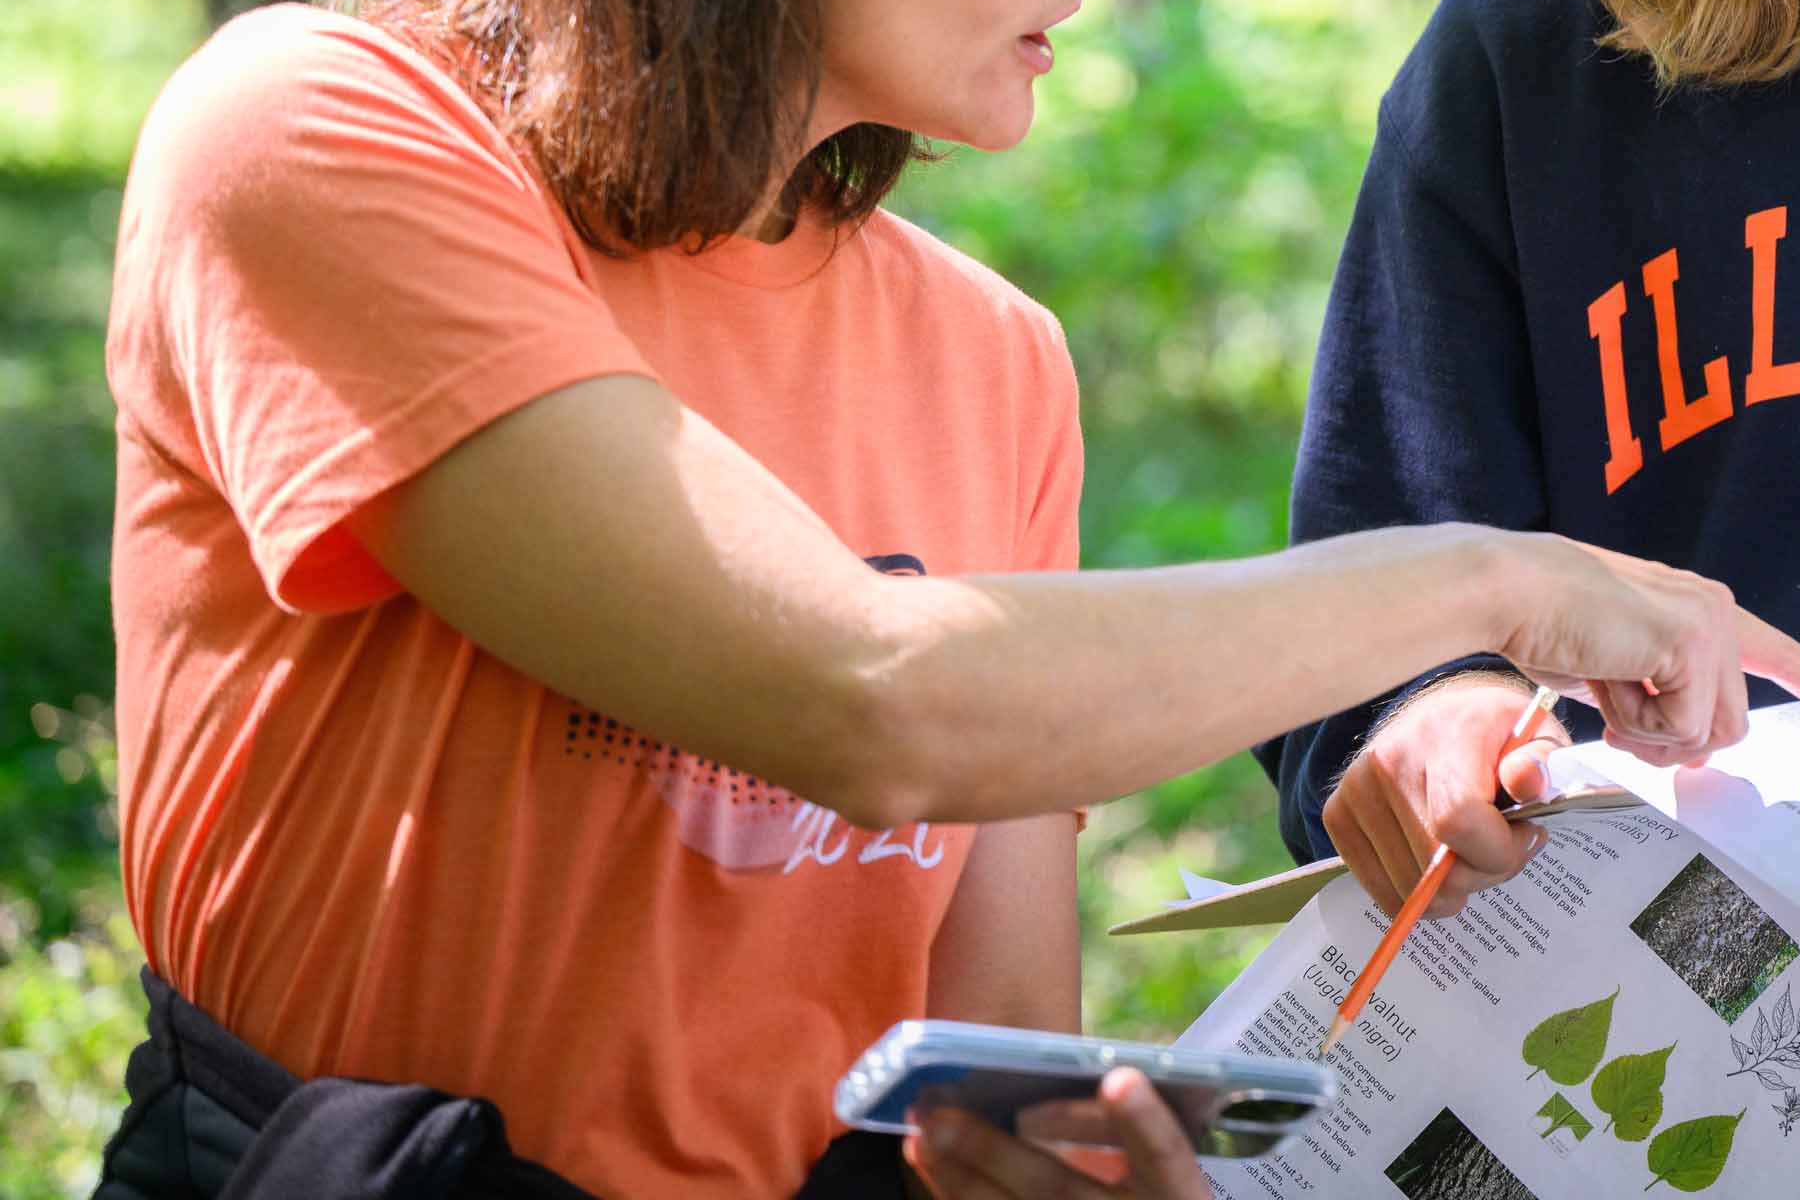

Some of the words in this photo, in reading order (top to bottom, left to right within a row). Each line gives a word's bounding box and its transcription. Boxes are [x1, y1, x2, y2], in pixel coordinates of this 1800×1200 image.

[1539, 850, 1559, 866] leaf
[1555, 862, 1566, 873] is
[1563, 870, 1593, 896] yellow
[1581, 845, 1602, 860] and
[1532, 876, 1543, 887] is
[1541, 884, 1561, 901] dull
[1555, 898, 1577, 918] pale
[1542, 869, 1562, 885] and
[1558, 882, 1588, 910] rough-
[1454, 910, 1476, 934] large
[1473, 932, 1497, 953] seed
[1487, 896, 1523, 930] irregular
[1521, 929, 1545, 955] ridges
[1502, 892, 1514, 905] to
[1512, 901, 1550, 939] brownish
[1406, 933, 1441, 964] sturbed
[1437, 962, 1459, 985] open
[1420, 926, 1450, 958] woods;
[1447, 954, 1473, 979] mesic
[1470, 976, 1501, 1006] upland
[1444, 931, 1455, 944] to
[1453, 941, 1478, 966] mesic
[1494, 933, 1520, 959] drupe
[1406, 949, 1448, 992] fencerows
[1262, 1007, 1293, 1039] leaflets
[1302, 963, 1349, 1007] (Jugla
[1357, 1019, 1402, 1062] nigra)
[1272, 998, 1297, 1026] leaves
[1335, 1061, 1355, 1081] with
[1353, 1077, 1374, 1099] 5-25
[1281, 990, 1319, 1027] Alternate
[1351, 1059, 1396, 1102] compound
[1254, 1017, 1295, 1058] lanceolate
[1342, 1106, 1371, 1136] serrate
[1330, 1129, 1356, 1158] below
[1332, 1115, 1352, 1132] and
[1279, 1160, 1297, 1177] nut
[1319, 1149, 1341, 1174] black
